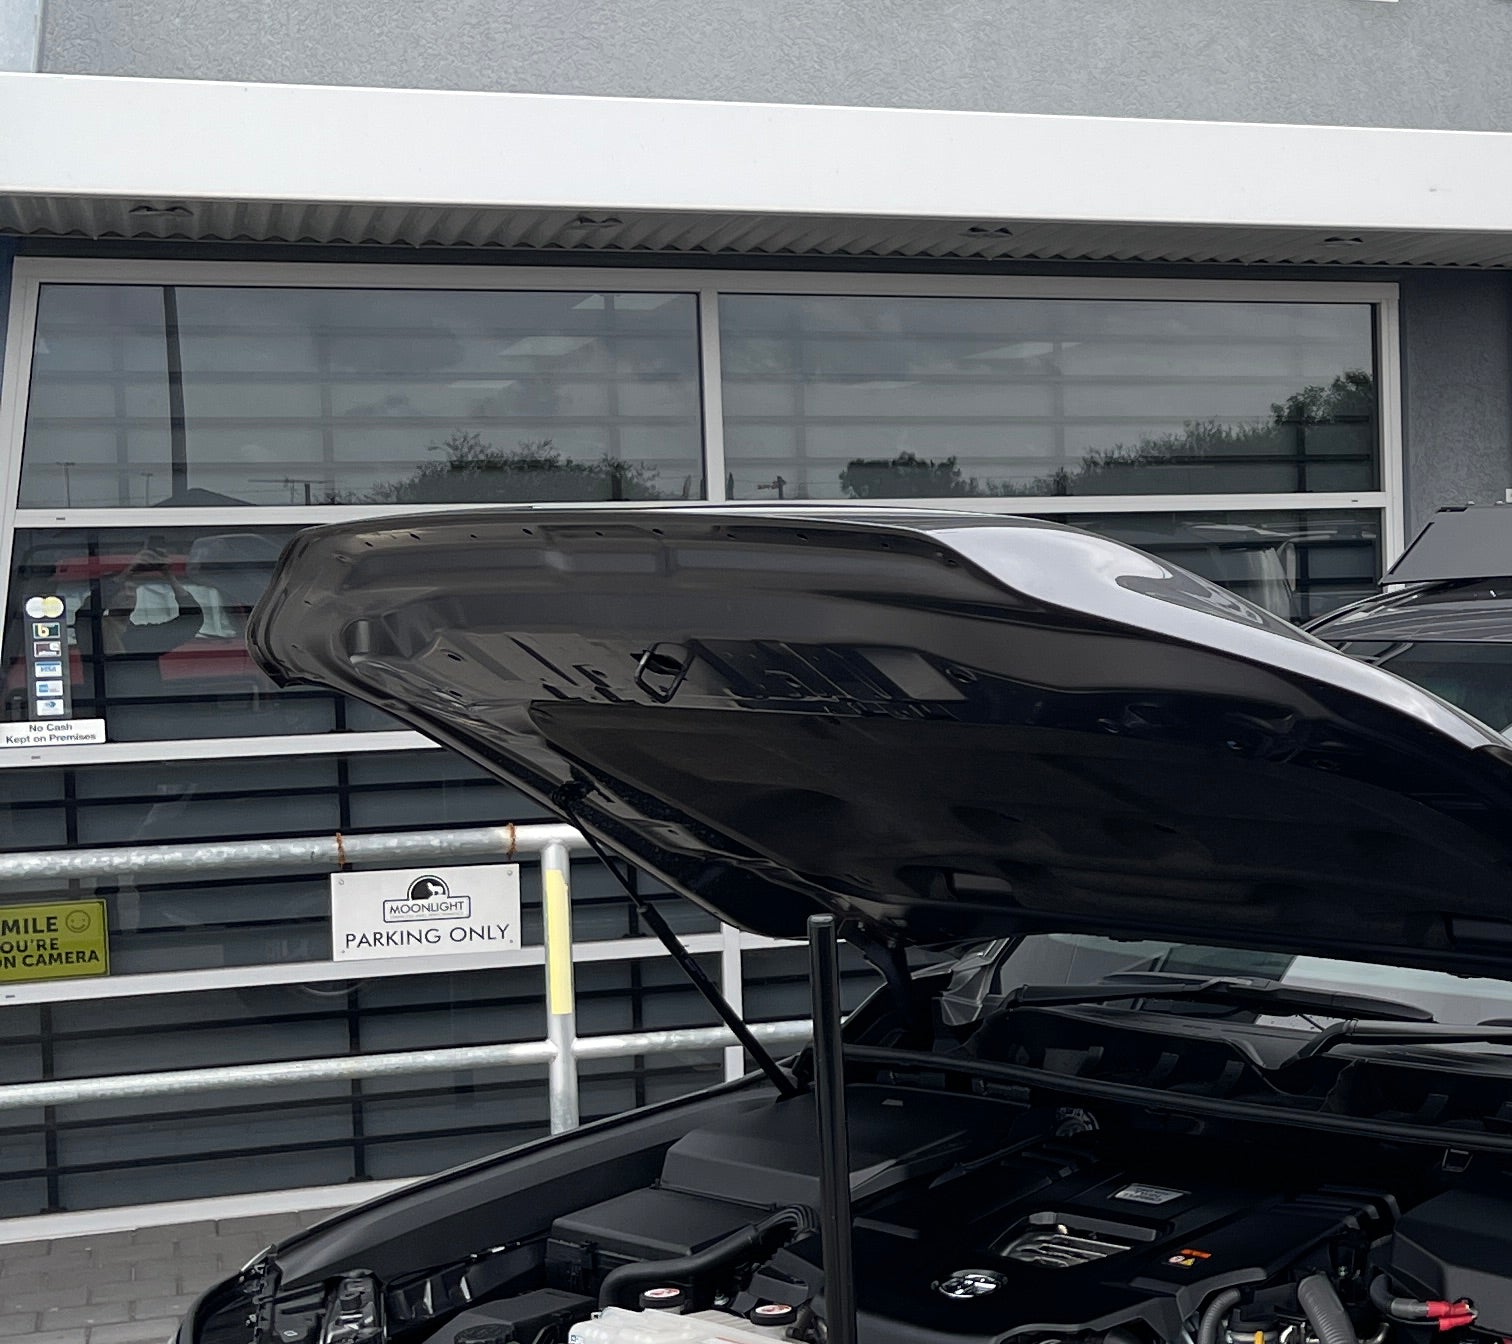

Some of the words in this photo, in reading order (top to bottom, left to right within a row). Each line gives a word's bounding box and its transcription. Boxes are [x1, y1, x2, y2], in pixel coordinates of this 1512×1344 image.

[29, 724, 44, 733] No
[46, 723, 73, 732] Cash
[6, 734, 31, 745] Kept
[33, 735, 47, 743] on
[49, 732, 96, 743] Premises
[389, 900, 465, 915] MOONLIGHT
[0, 916, 59, 936] MILE
[346, 928, 441, 949] PARKING
[450, 923, 510, 943] ONLY
[0, 937, 60, 954] OU'RE
[0, 954, 16, 970] N
[22, 949, 100, 968] CAMERA
